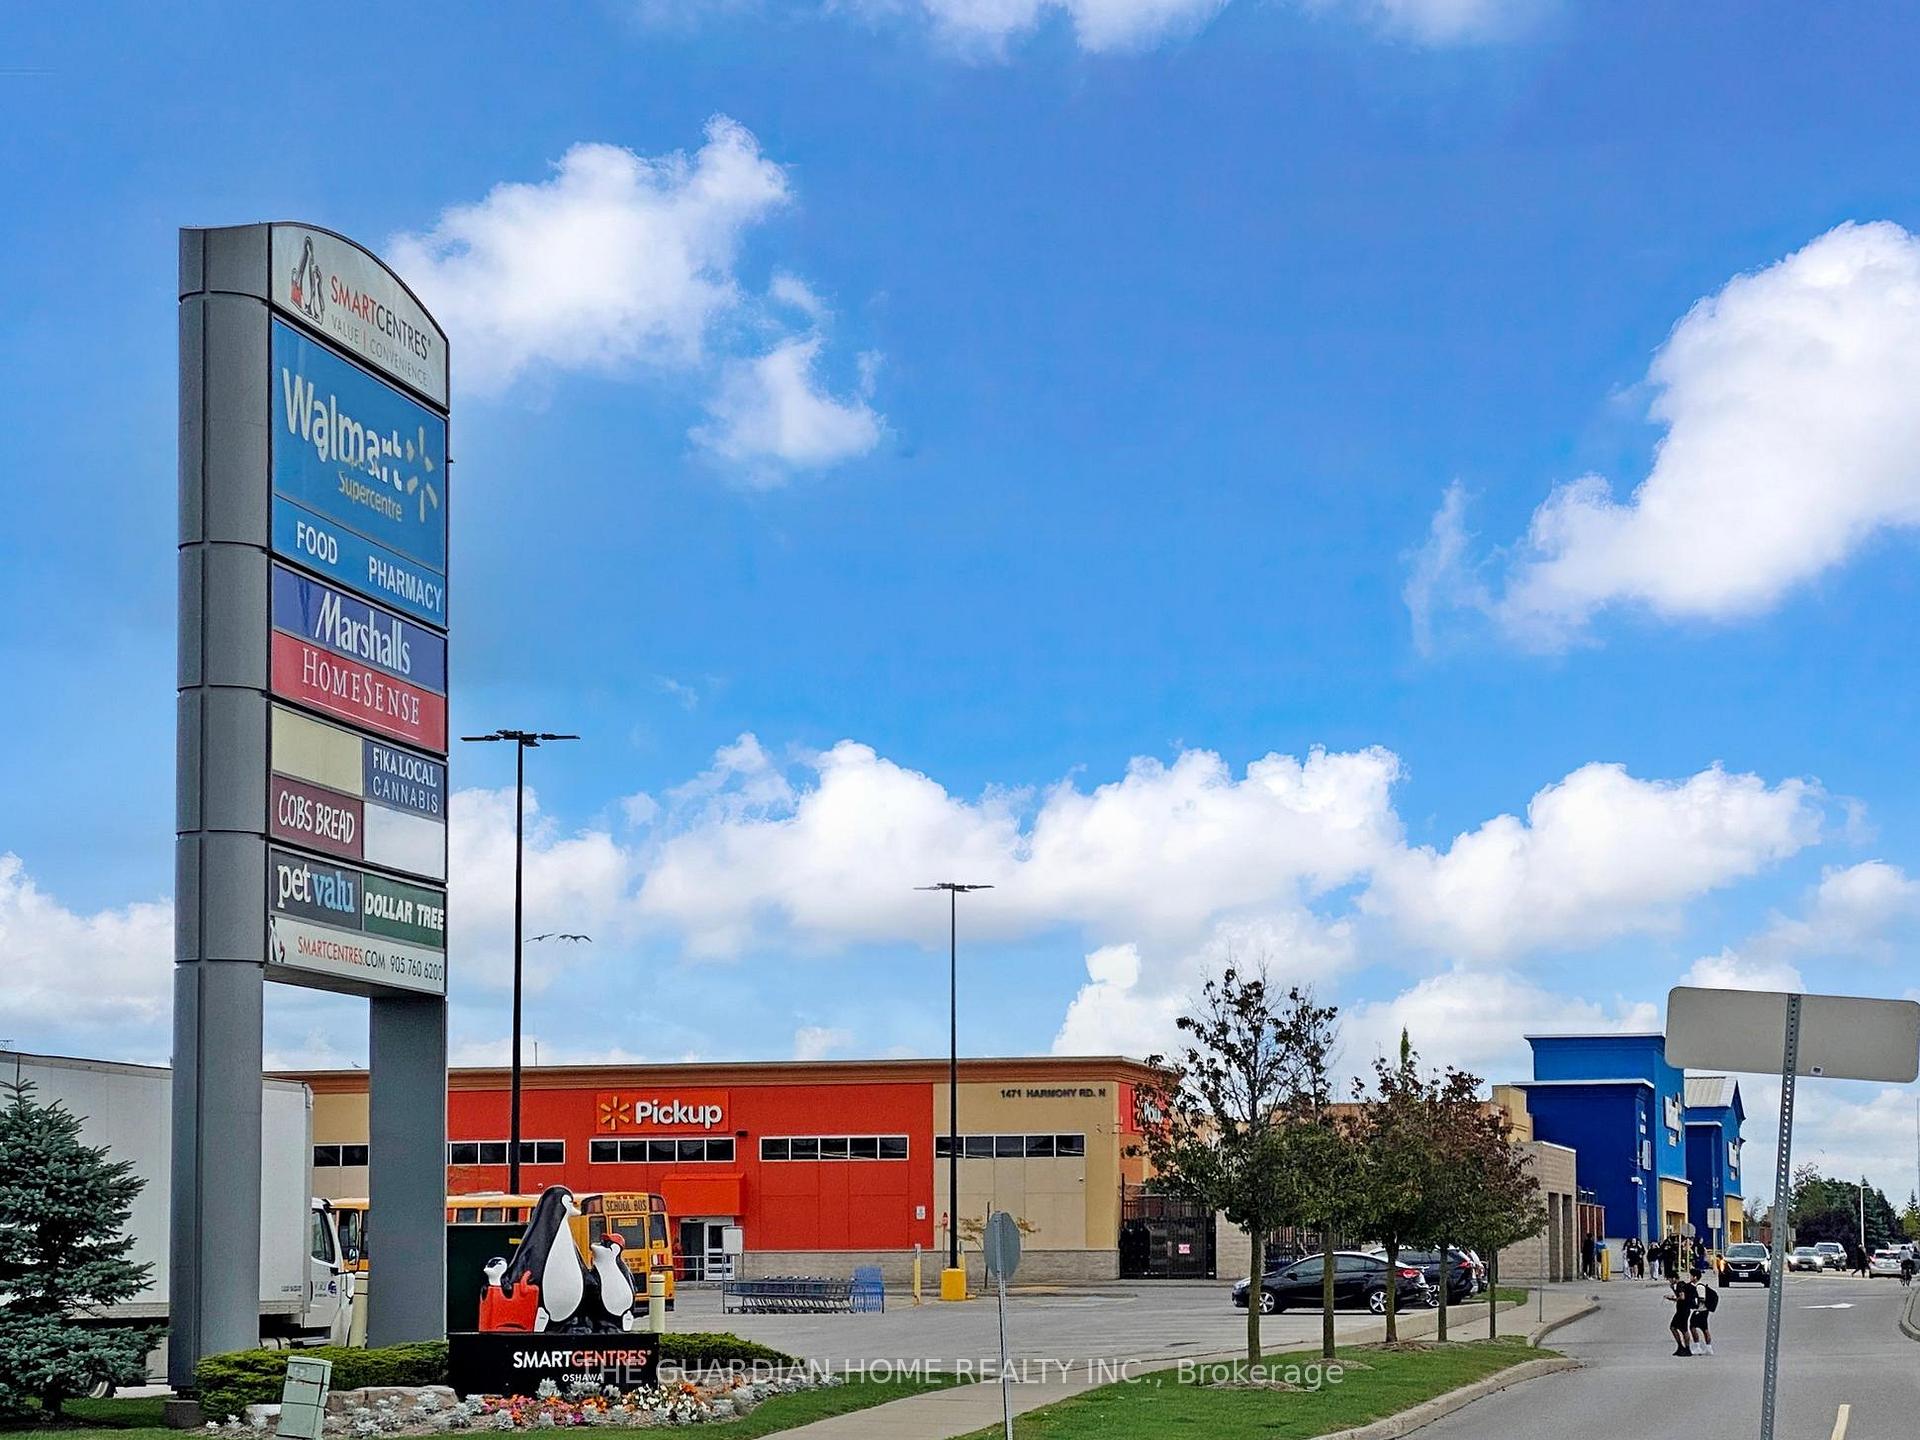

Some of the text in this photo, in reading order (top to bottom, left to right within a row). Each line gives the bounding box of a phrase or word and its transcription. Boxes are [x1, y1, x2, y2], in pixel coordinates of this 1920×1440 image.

[331, 275, 428, 361] SMARTCENTRES
[331, 314, 428, 387] VALUE CONVENIENCE
[283, 367, 403, 492] Walmart
[337, 470, 403, 522] Supercentre
[296, 521, 338, 565] FOOD
[368, 555, 443, 613] PHARMACY
[315, 591, 412, 675] Marshalls
[302, 648, 420, 725] HOMESENSE
[373, 747, 437, 787] FIKA LOCAL
[278, 790, 355, 845] COBS BREAD
[373, 777, 438, 814] CANNABIS
[277, 864, 355, 913] pet valu
[364, 891, 444, 932] DOLLAR TREE
[298, 936, 443, 982] SMARTCENTRES.COM 905 760 6200
[635, 1099, 723, 1130] Pickup
[1000, 1088, 1022, 1099] 1471
[1026, 1088, 1077, 1099] HARMONY
[605, 1200, 648, 1213] SCHOOL BUS
[513, 1350, 648, 1369] SMARTCENTRES
[562, 1373, 604, 1383] OSHAWA
